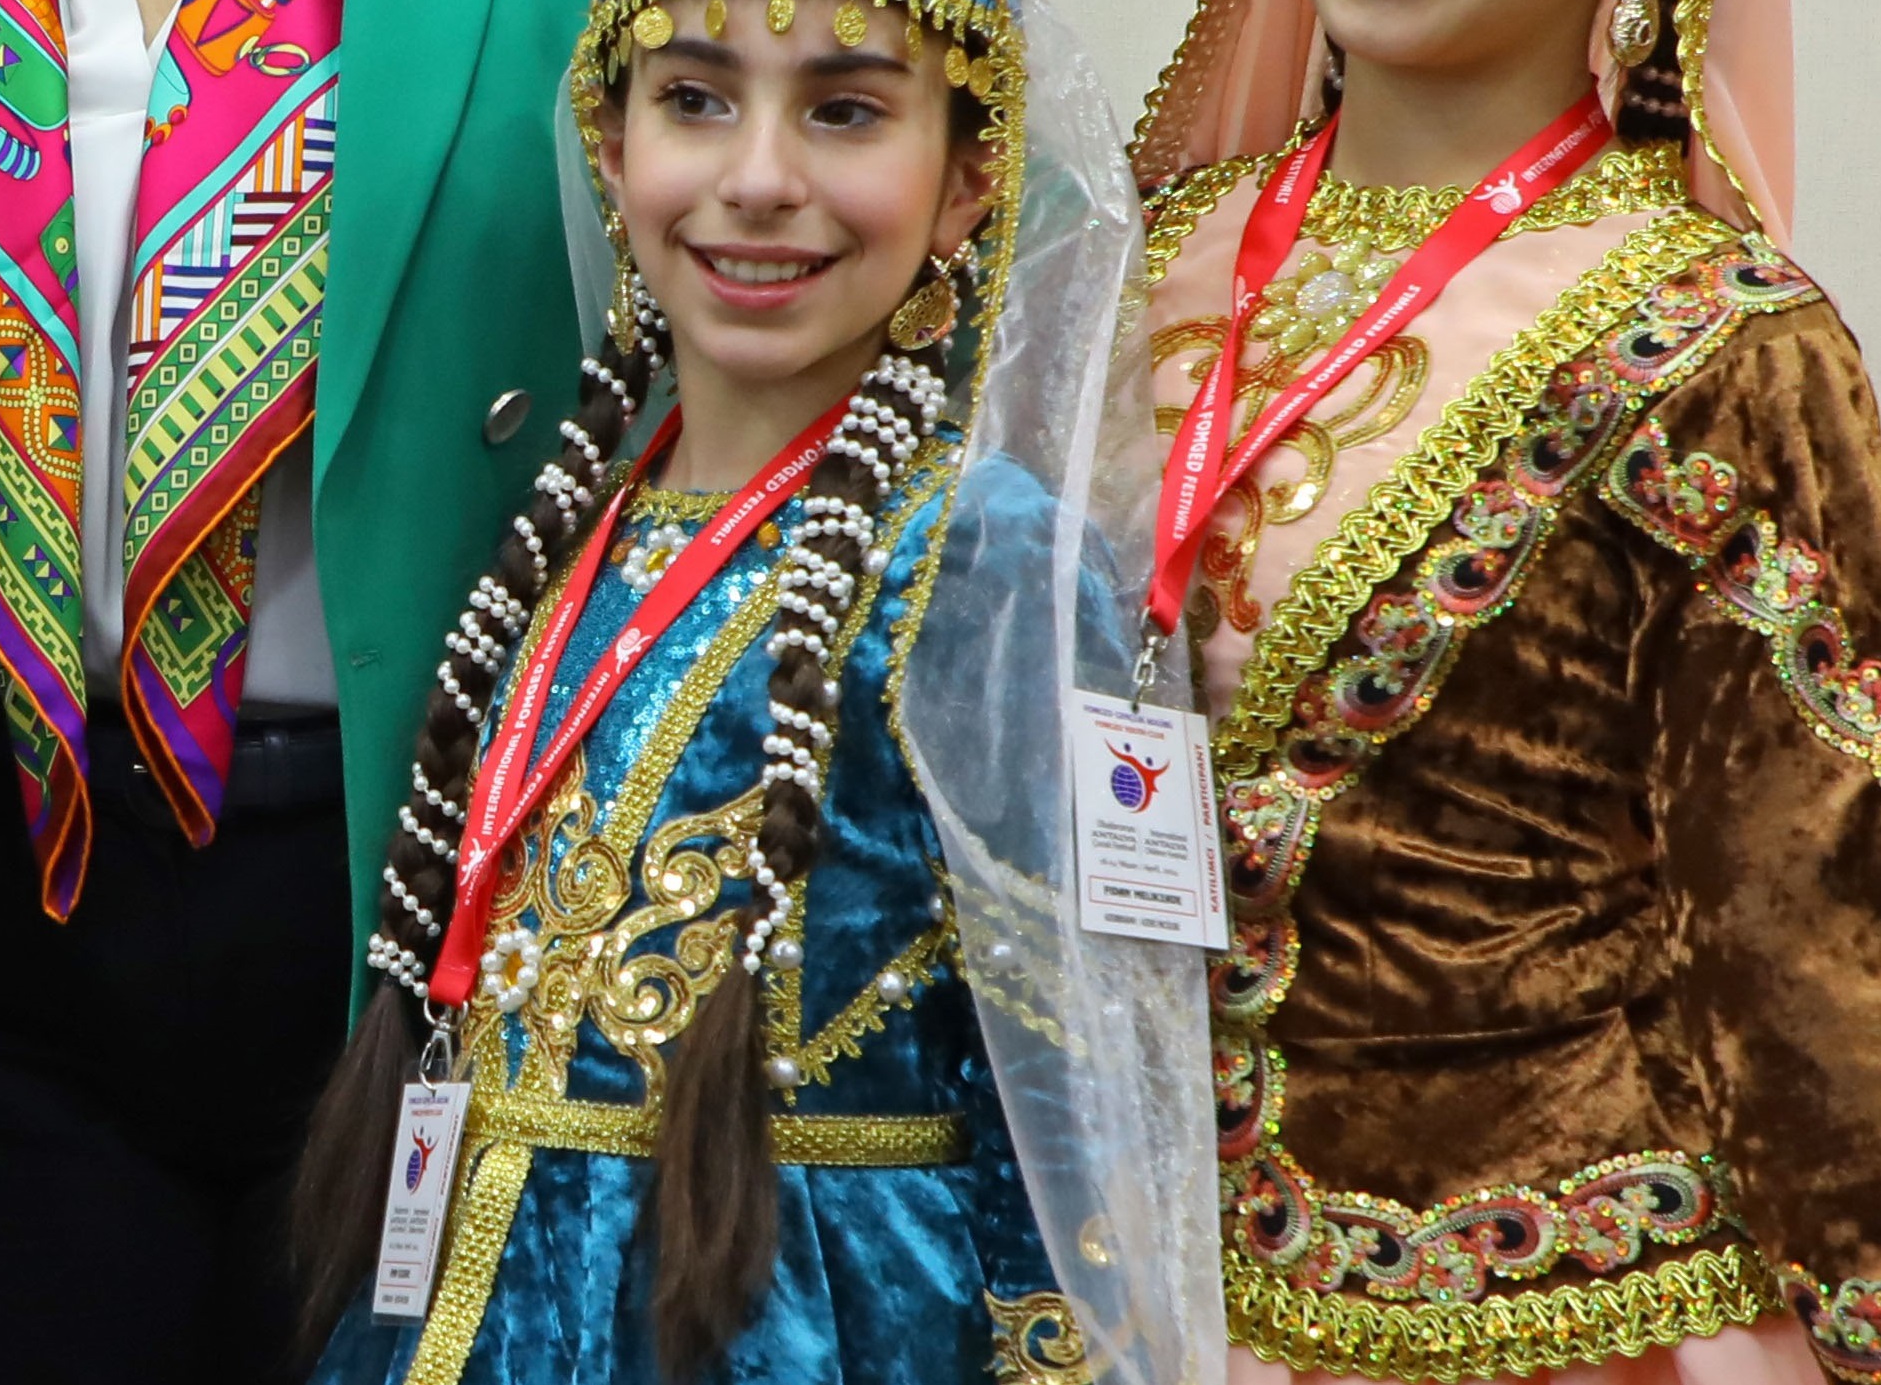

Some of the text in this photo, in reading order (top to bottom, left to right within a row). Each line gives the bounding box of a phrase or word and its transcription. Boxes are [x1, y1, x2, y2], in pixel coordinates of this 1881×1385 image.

[1274, 153, 1307, 204] FESTIVALS
[1230, 284, 1421, 476] INTERNATIONAL FOMGED FESTIVALS
[1185, 410, 1215, 473] FOMGED
[711, 490, 766, 546] FESTIVALS
[1172, 475, 1198, 541] FESTIVALS
[482, 600, 574, 836] INTERNATIONAL FOMGED FESTIVALS
[543, 671, 610, 769] INTERNATIONAL
[1194, 744, 1211, 826] PARTICIPANT
